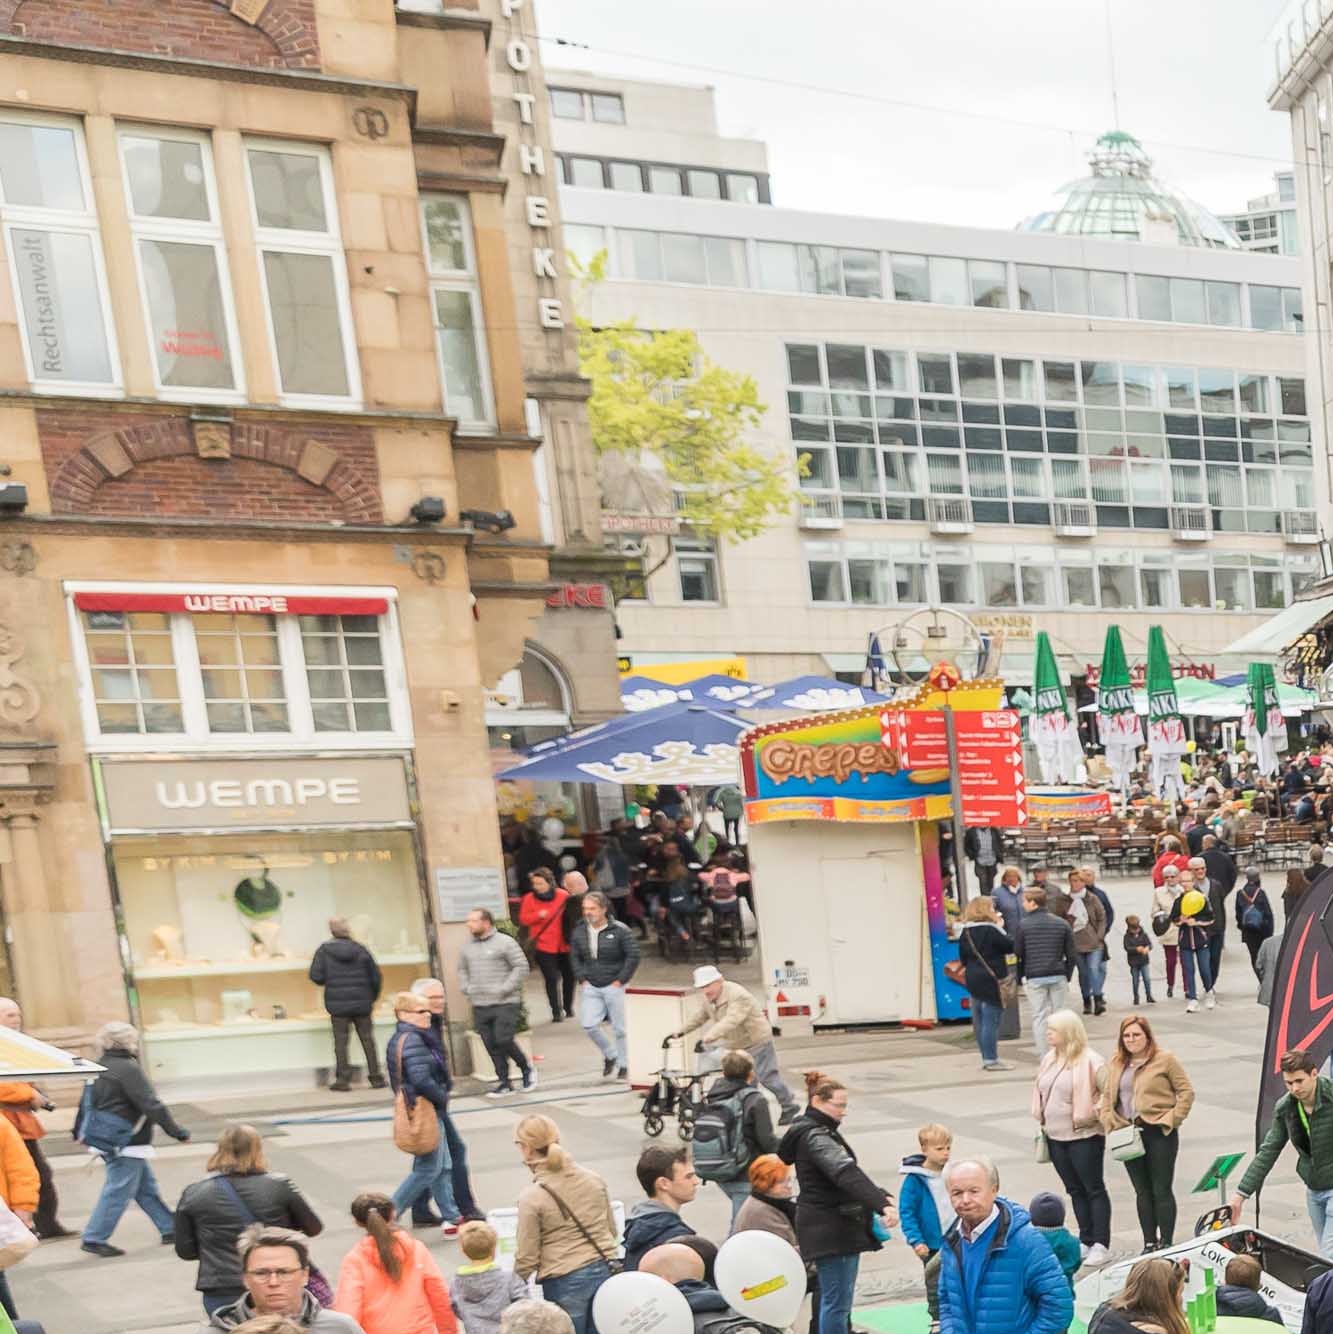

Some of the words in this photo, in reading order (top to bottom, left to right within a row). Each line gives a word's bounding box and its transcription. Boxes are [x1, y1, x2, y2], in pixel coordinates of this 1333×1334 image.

[21, 236, 63, 373] Rechtsanwalt
[184, 595, 289, 613] WEMPE
[157, 778, 361, 809] WEMPE
